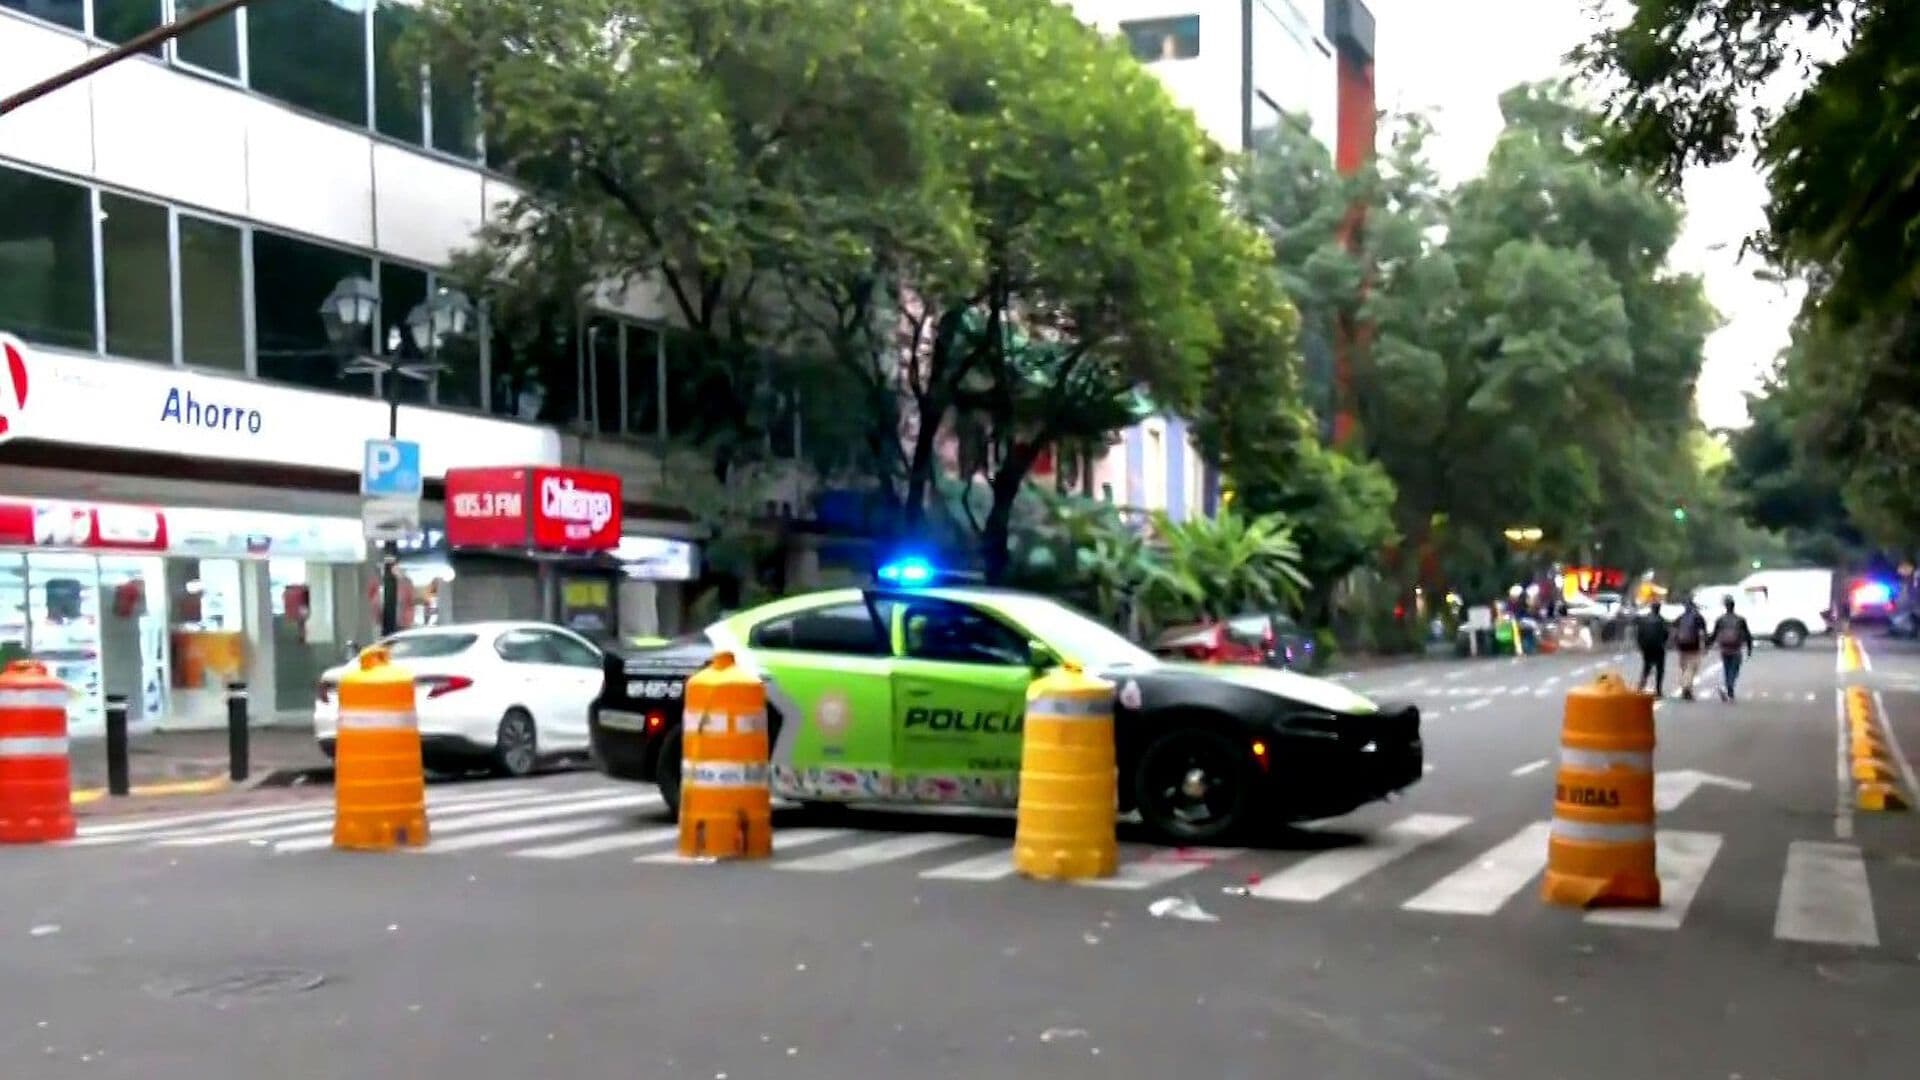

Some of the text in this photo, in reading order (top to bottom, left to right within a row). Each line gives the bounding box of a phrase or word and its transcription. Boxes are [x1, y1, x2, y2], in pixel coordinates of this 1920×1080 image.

[160, 386, 262, 434] Ahorro
[368, 444, 400, 481] P
[453, 492, 522, 518] 105.3 FM
